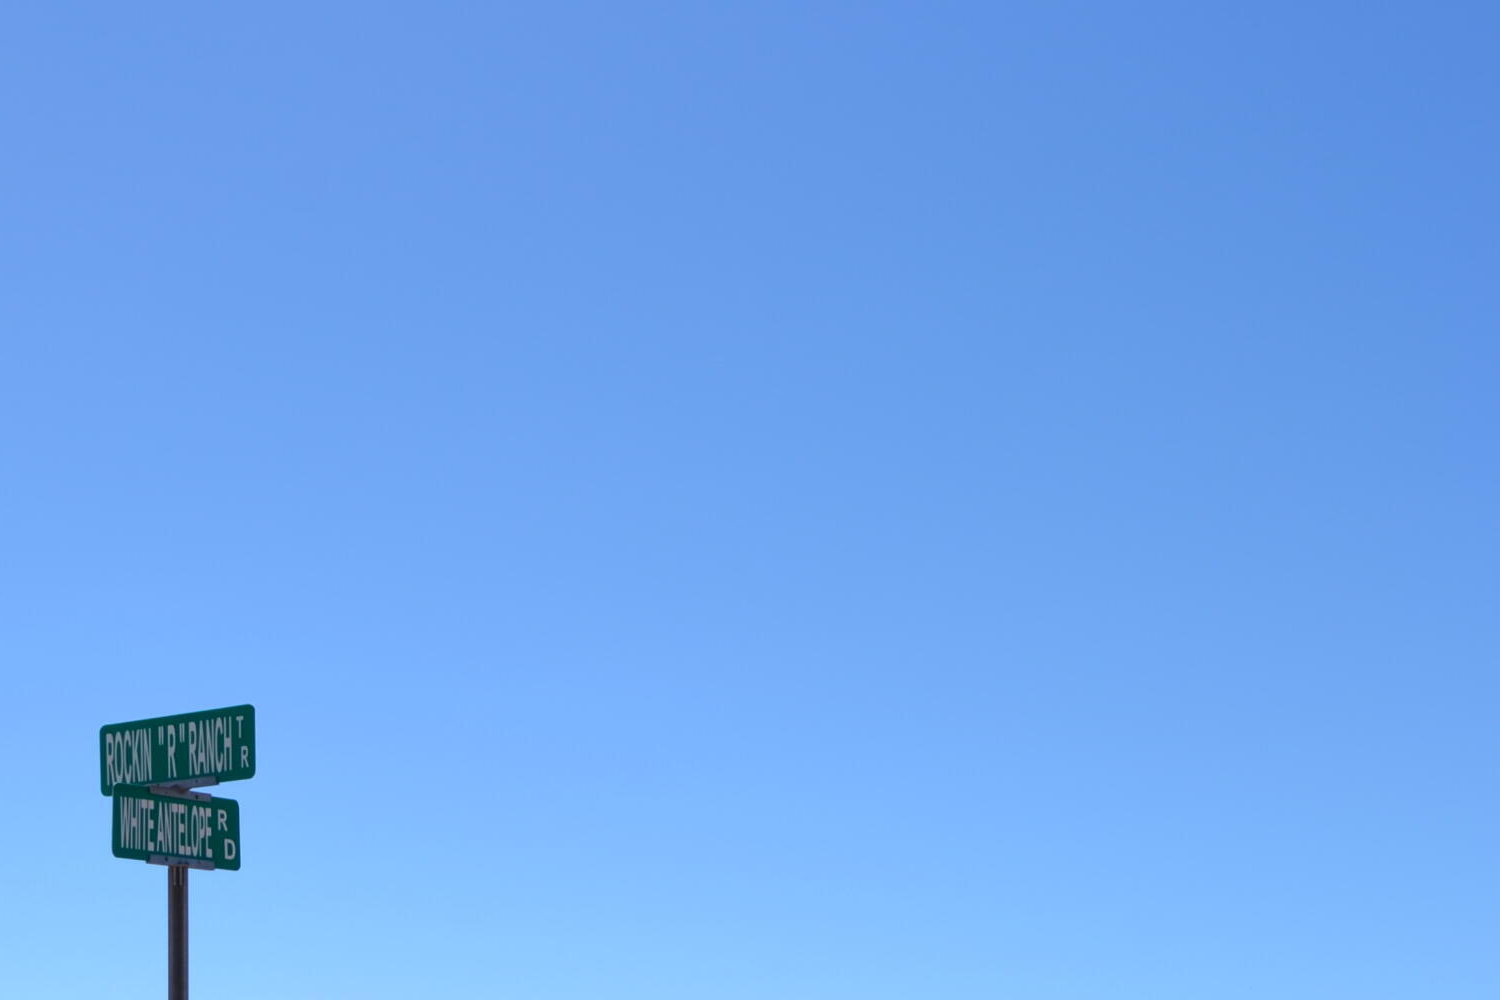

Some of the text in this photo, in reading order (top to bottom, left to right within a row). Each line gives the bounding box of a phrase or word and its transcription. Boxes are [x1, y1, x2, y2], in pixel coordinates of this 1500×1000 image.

[106, 728, 152, 785] ROCKIN
[158, 723, 185, 778] "R"
[188, 716, 232, 776] RANCH
[120, 796, 154, 851] WHITE
[157, 802, 213, 858] ANTELOPE
